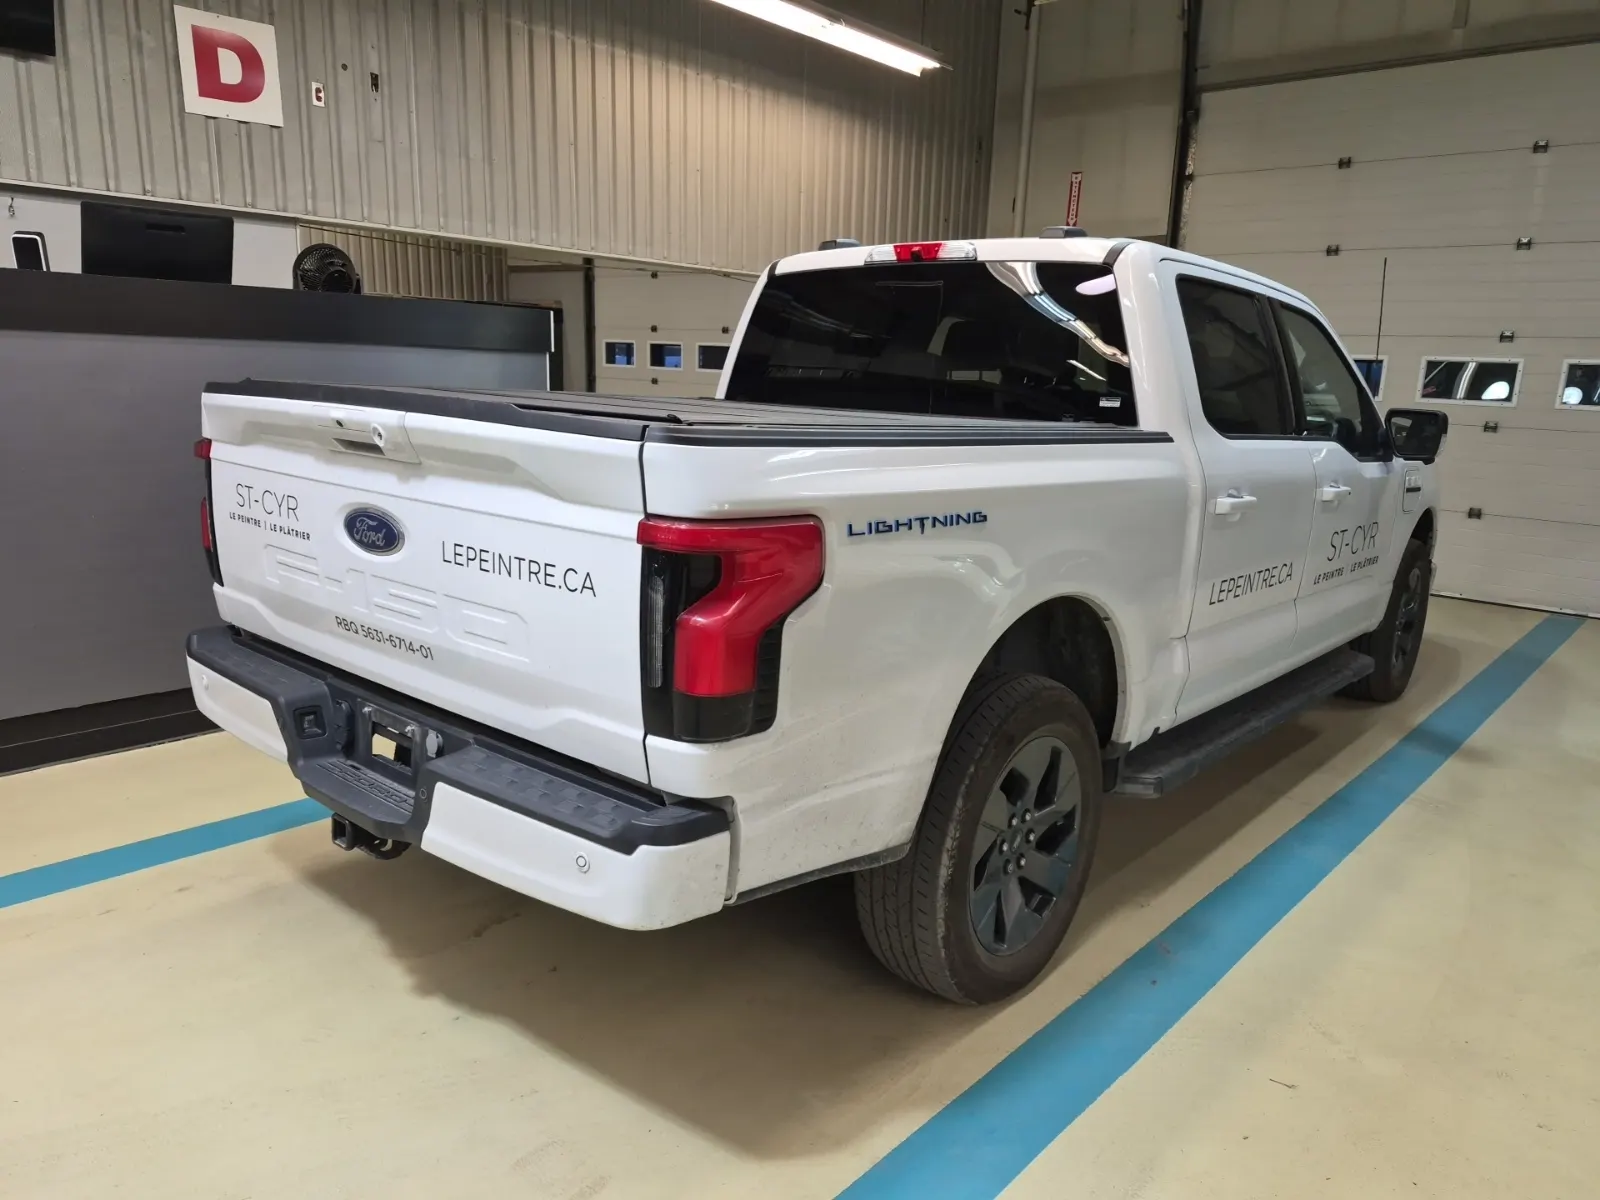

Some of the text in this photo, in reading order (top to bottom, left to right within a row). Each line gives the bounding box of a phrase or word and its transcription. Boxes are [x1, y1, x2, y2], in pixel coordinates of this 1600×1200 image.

[190, 23, 266, 104] D
[229, 511, 237, 521] LE
[237, 513, 262, 528] PEINTRE
[269, 521, 278, 533] LE
[235, 482, 300, 522] ST-CYR
[353, 516, 387, 547] Ford
[846, 510, 988, 537] LIGHTNING
[1326, 521, 1379, 562] ST-CYR
[441, 540, 598, 598] LEPEINTRE.CA
[1208, 561, 1294, 606] LEPEINTRE.CA
[1313, 574, 1322, 585] LE
[1321, 566, 1345, 583] PEINTRE
[264, 542, 532, 663] F-150
[334, 615, 434, 661] RBQ 5631-6714-01
